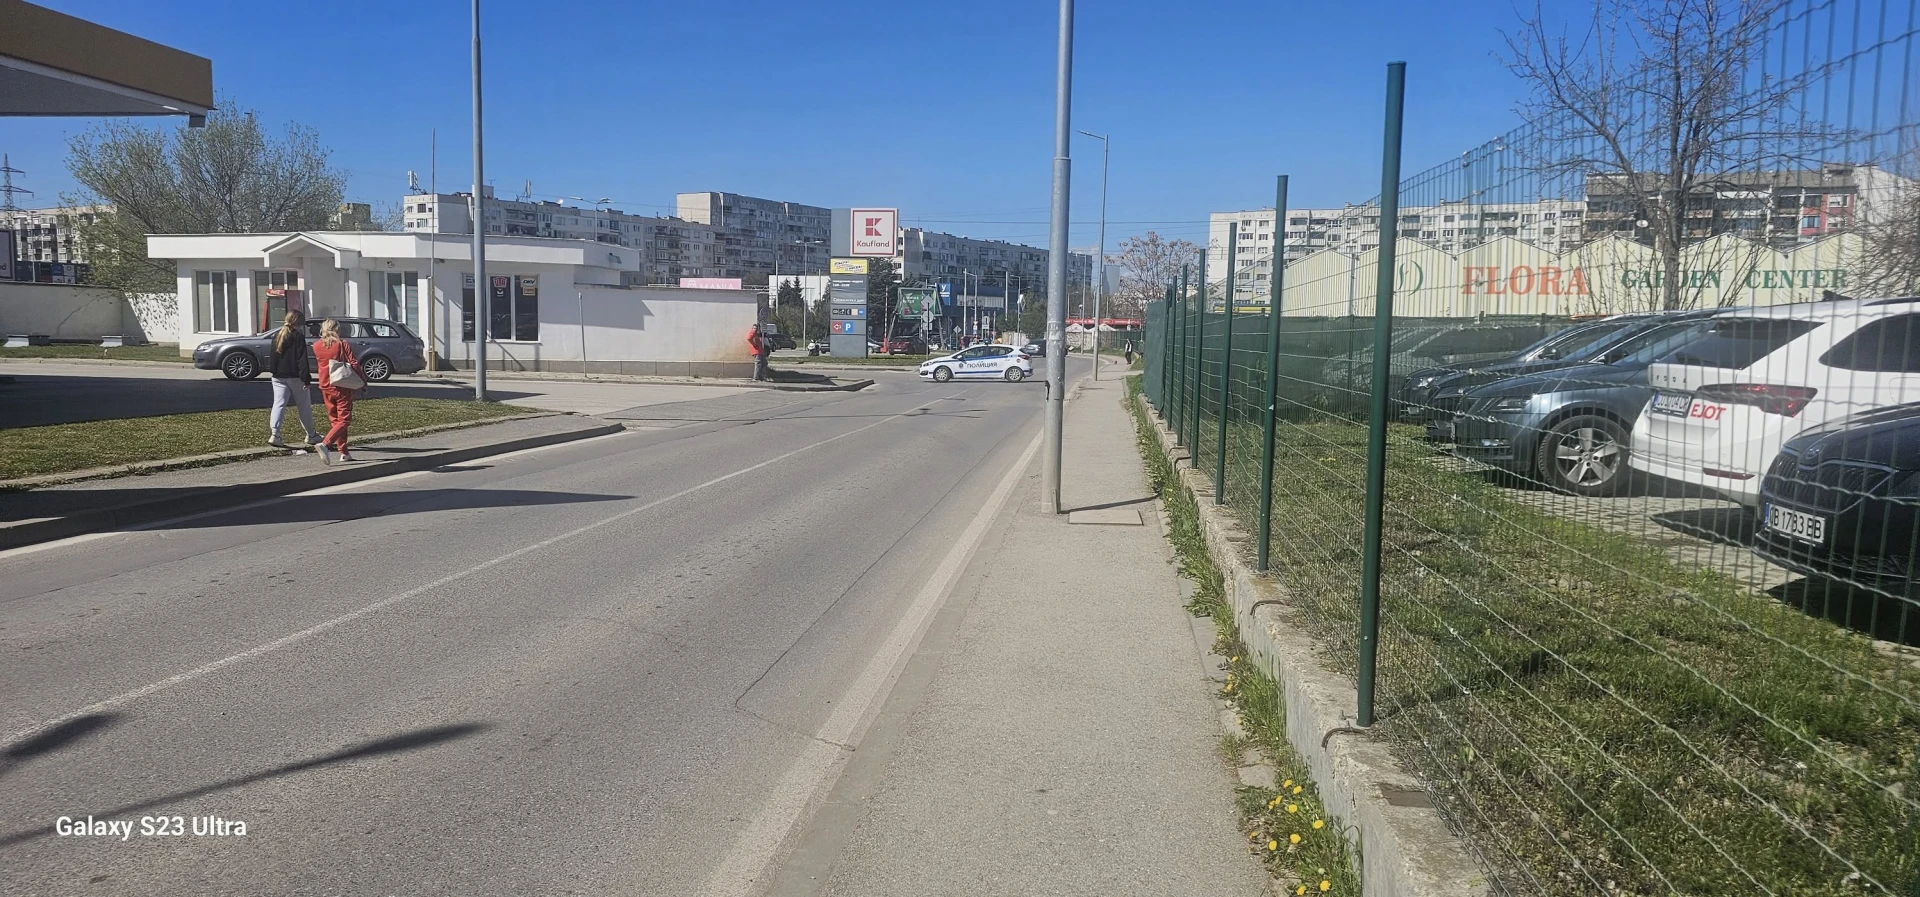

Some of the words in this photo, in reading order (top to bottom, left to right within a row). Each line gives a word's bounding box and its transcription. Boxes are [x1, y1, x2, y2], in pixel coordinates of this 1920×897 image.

[865, 218, 882, 236] K
[857, 240, 890, 248] Kaufland
[1461, 265, 1589, 295] FLORA
[1621, 269, 1720, 289] GARDEN
[1745, 269, 1848, 289] CENTER
[845, 323, 852, 331] P
[1690, 403, 1727, 421] EJOT
